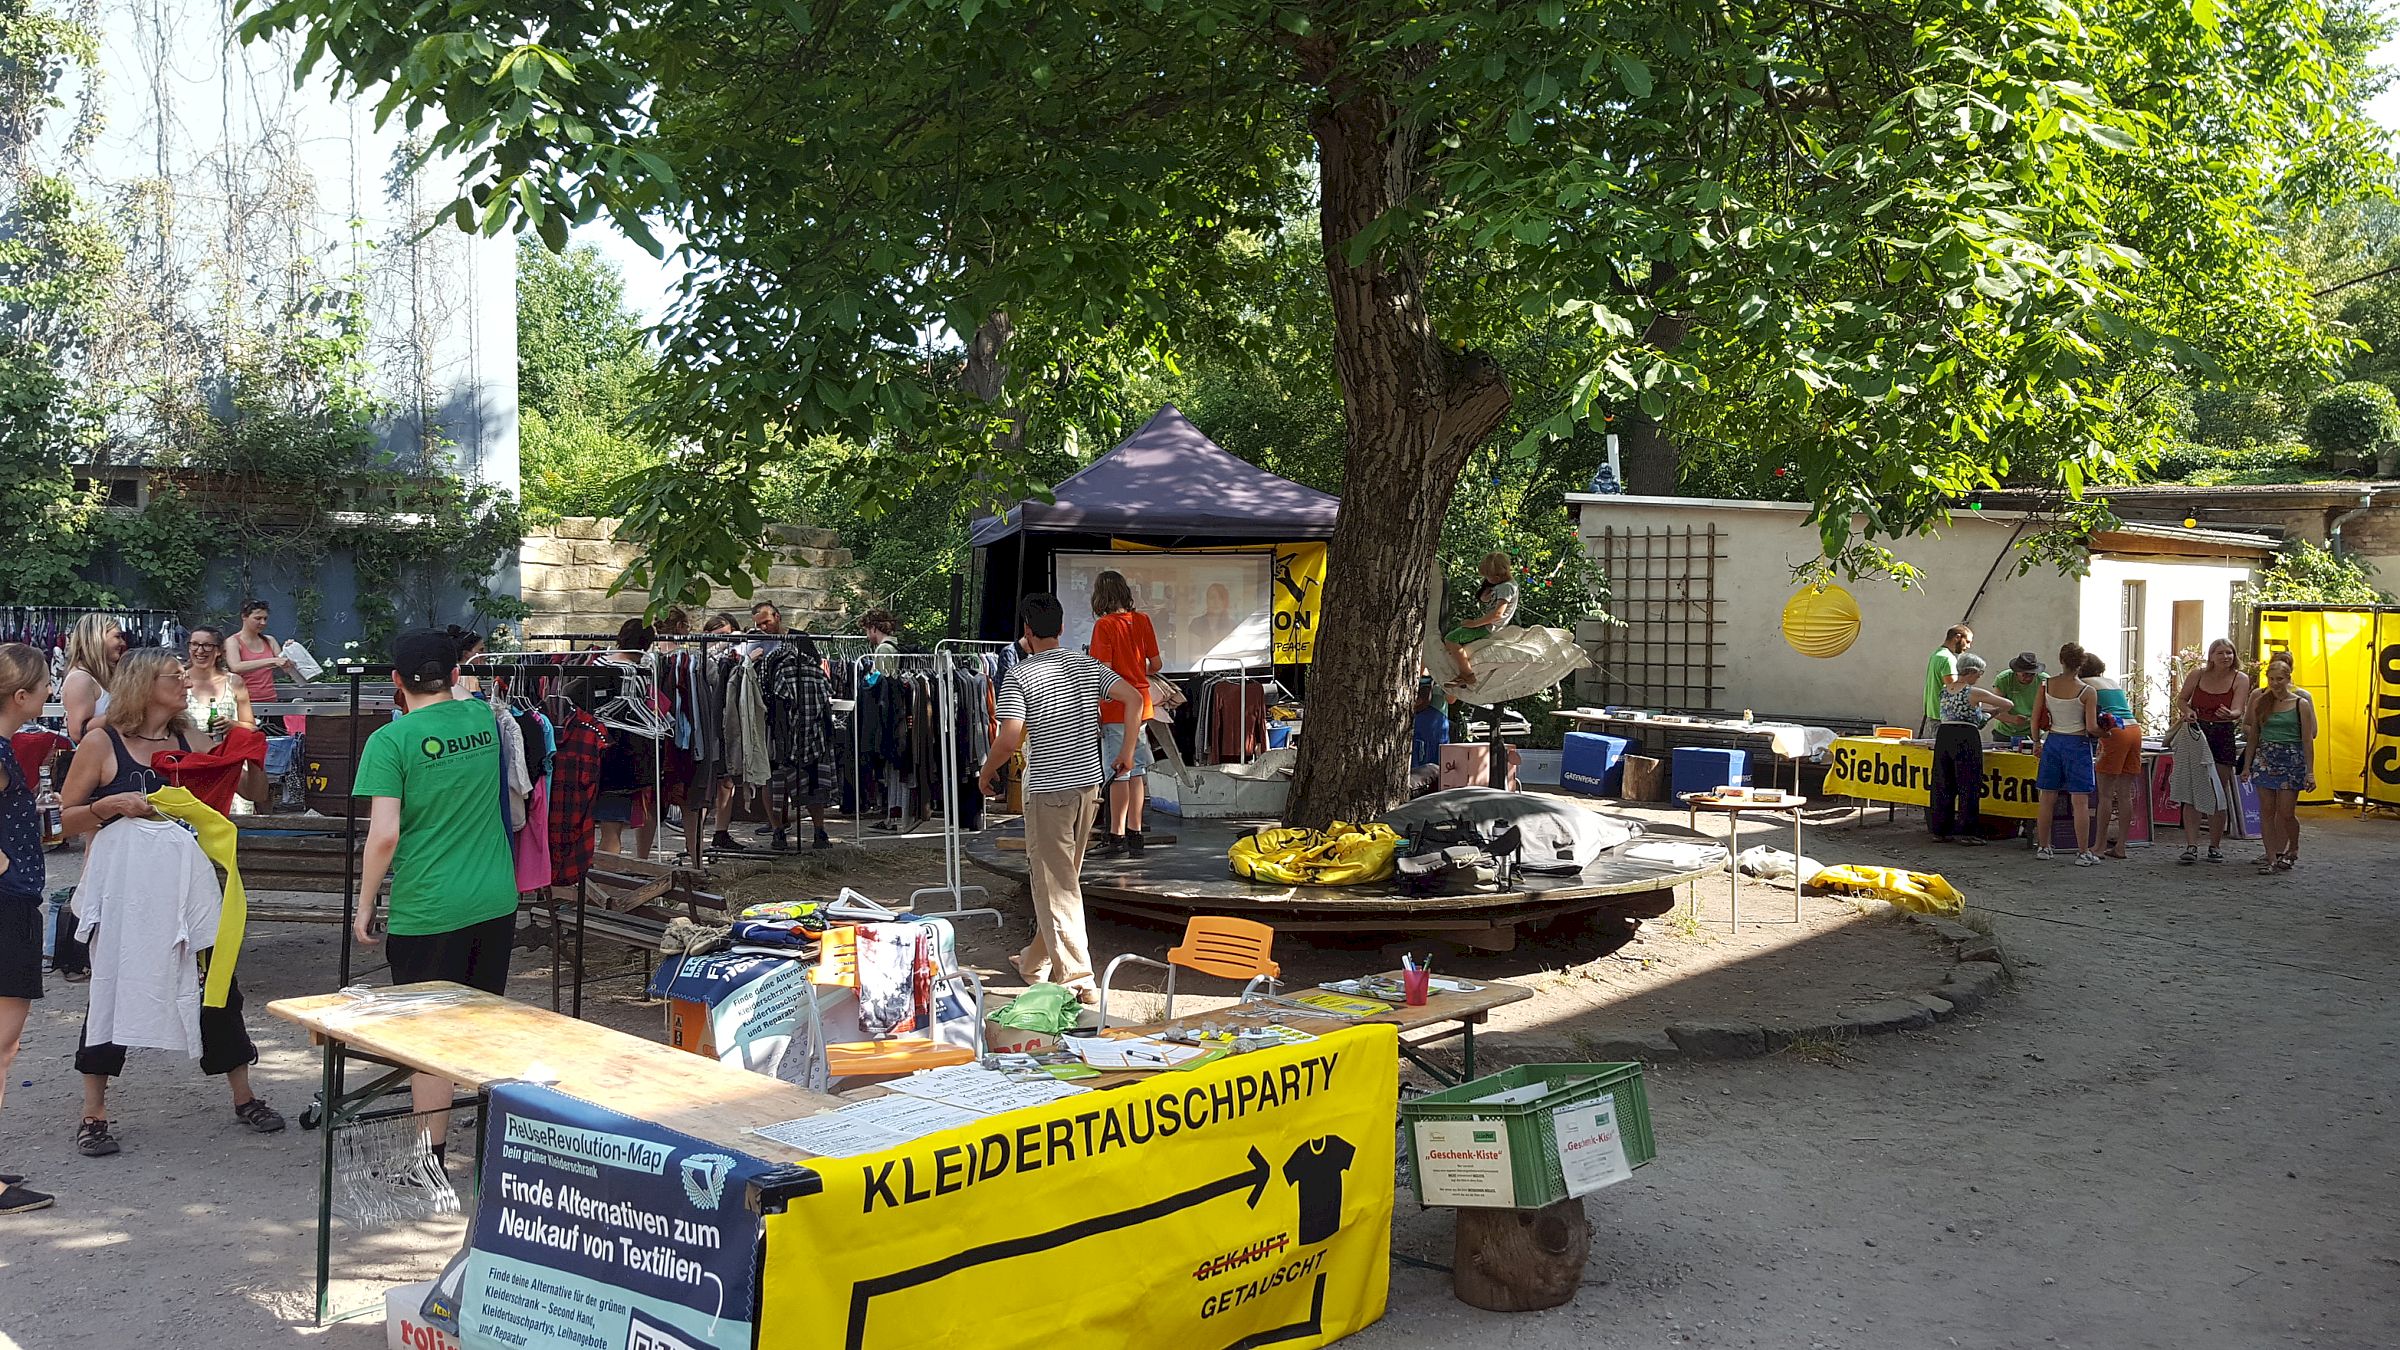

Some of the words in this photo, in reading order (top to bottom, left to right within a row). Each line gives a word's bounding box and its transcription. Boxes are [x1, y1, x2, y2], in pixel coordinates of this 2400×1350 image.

[1274, 610, 1311, 631] ON
[1273, 641, 1311, 654] PEACE
[446, 731, 493, 754] BUND
[1564, 771, 1601, 785] GREENPEACE
[733, 992, 754, 1008] Finde
[755, 980, 775, 996] deine
[738, 983, 793, 1017] Kleiderschrank
[747, 1025, 762, 1038] und
[763, 1006, 800, 1030] Reparatur
[508, 1116, 663, 1174] ReUseRevolution-Map
[861, 1052, 1340, 1213] KLEIDERTAUSCHPARTY
[502, 1144, 522, 1160] Dein
[523, 1149, 547, 1165] grüner
[548, 1153, 599, 1179] Kleiderschrank
[1425, 1149, 1503, 1161] „Geschenk-Kiste“
[501, 1172, 553, 1208] Finde
[557, 1184, 669, 1238] Alternativen
[674, 1218, 721, 1249] zum
[498, 1207, 580, 1252] Neukauf
[583, 1233, 614, 1263] von
[619, 1237, 703, 1286] Textilien
[1196, 1231, 1288, 1282] GEKAUFT
[489, 1267, 511, 1284] Finde
[511, 1272, 530, 1289] deine
[531, 1278, 573, 1300] Alternative
[573, 1289, 587, 1303] für
[599, 1297, 627, 1316] grünen
[1201, 1249, 1328, 1319] GETAUSCHT
[485, 1285, 540, 1311] Kleiderschrank
[548, 1302, 575, 1321] Second
[400, 1319, 458, 1350] roli
[478, 1322, 493, 1336] und
[493, 1327, 528, 1347] Reparatur
[481, 1303, 555, 1336] Kleidertauschpartys,
[557, 1324, 608, 1350] Leihangebote
